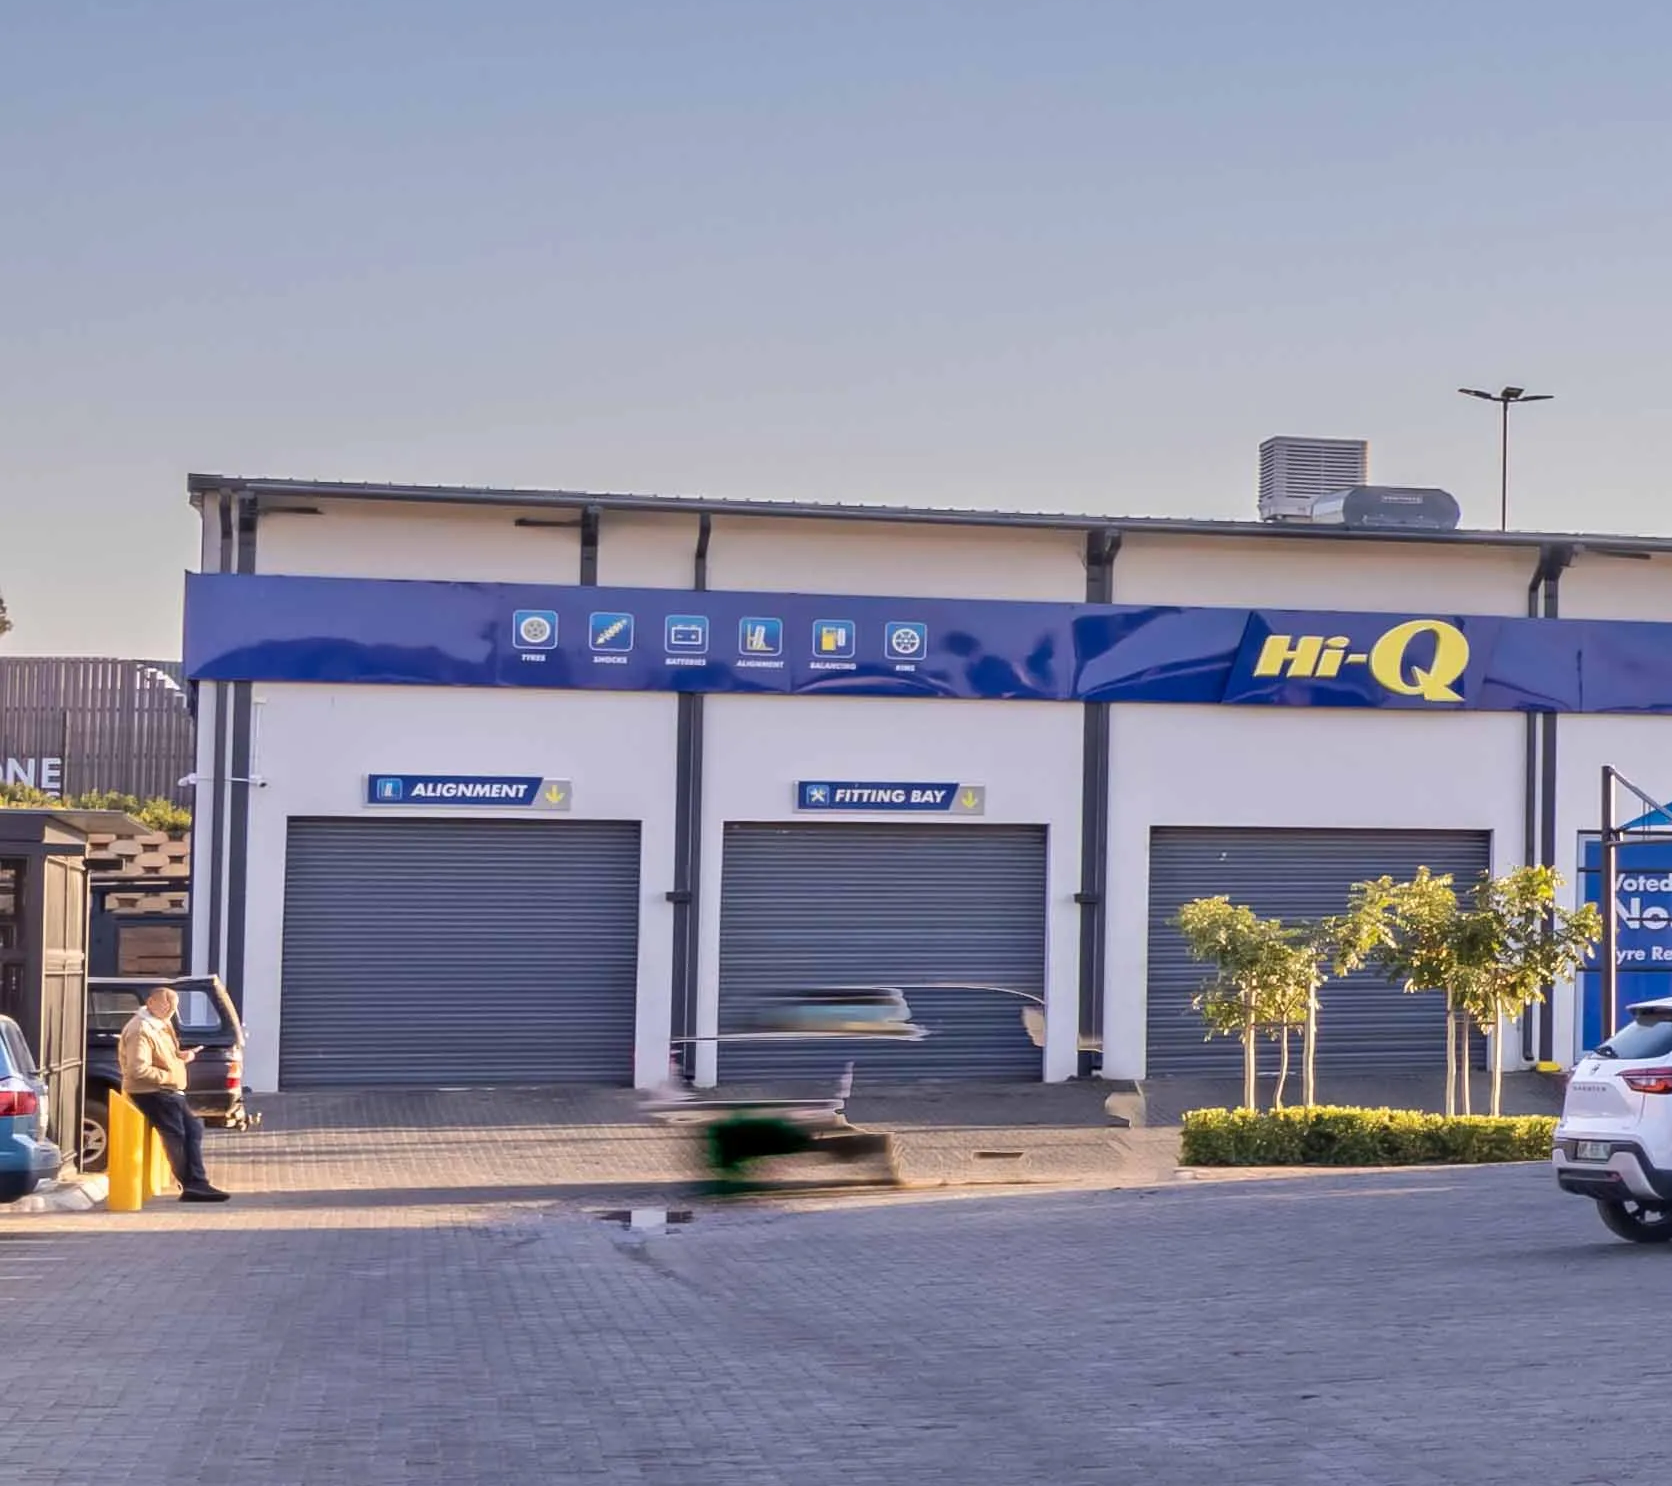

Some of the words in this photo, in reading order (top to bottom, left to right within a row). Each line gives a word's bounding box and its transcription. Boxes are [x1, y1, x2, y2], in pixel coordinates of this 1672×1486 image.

[736, 660, 785, 668] ALIGNMENT
[1254, 619, 1470, 701] Hi-Q
[0, 757, 62, 789] NE
[411, 783, 528, 798] ALIGNMENT
[835, 789, 905, 804] FITTING
[910, 790, 946, 804] BAY
[1615, 945, 1645, 965] yre
